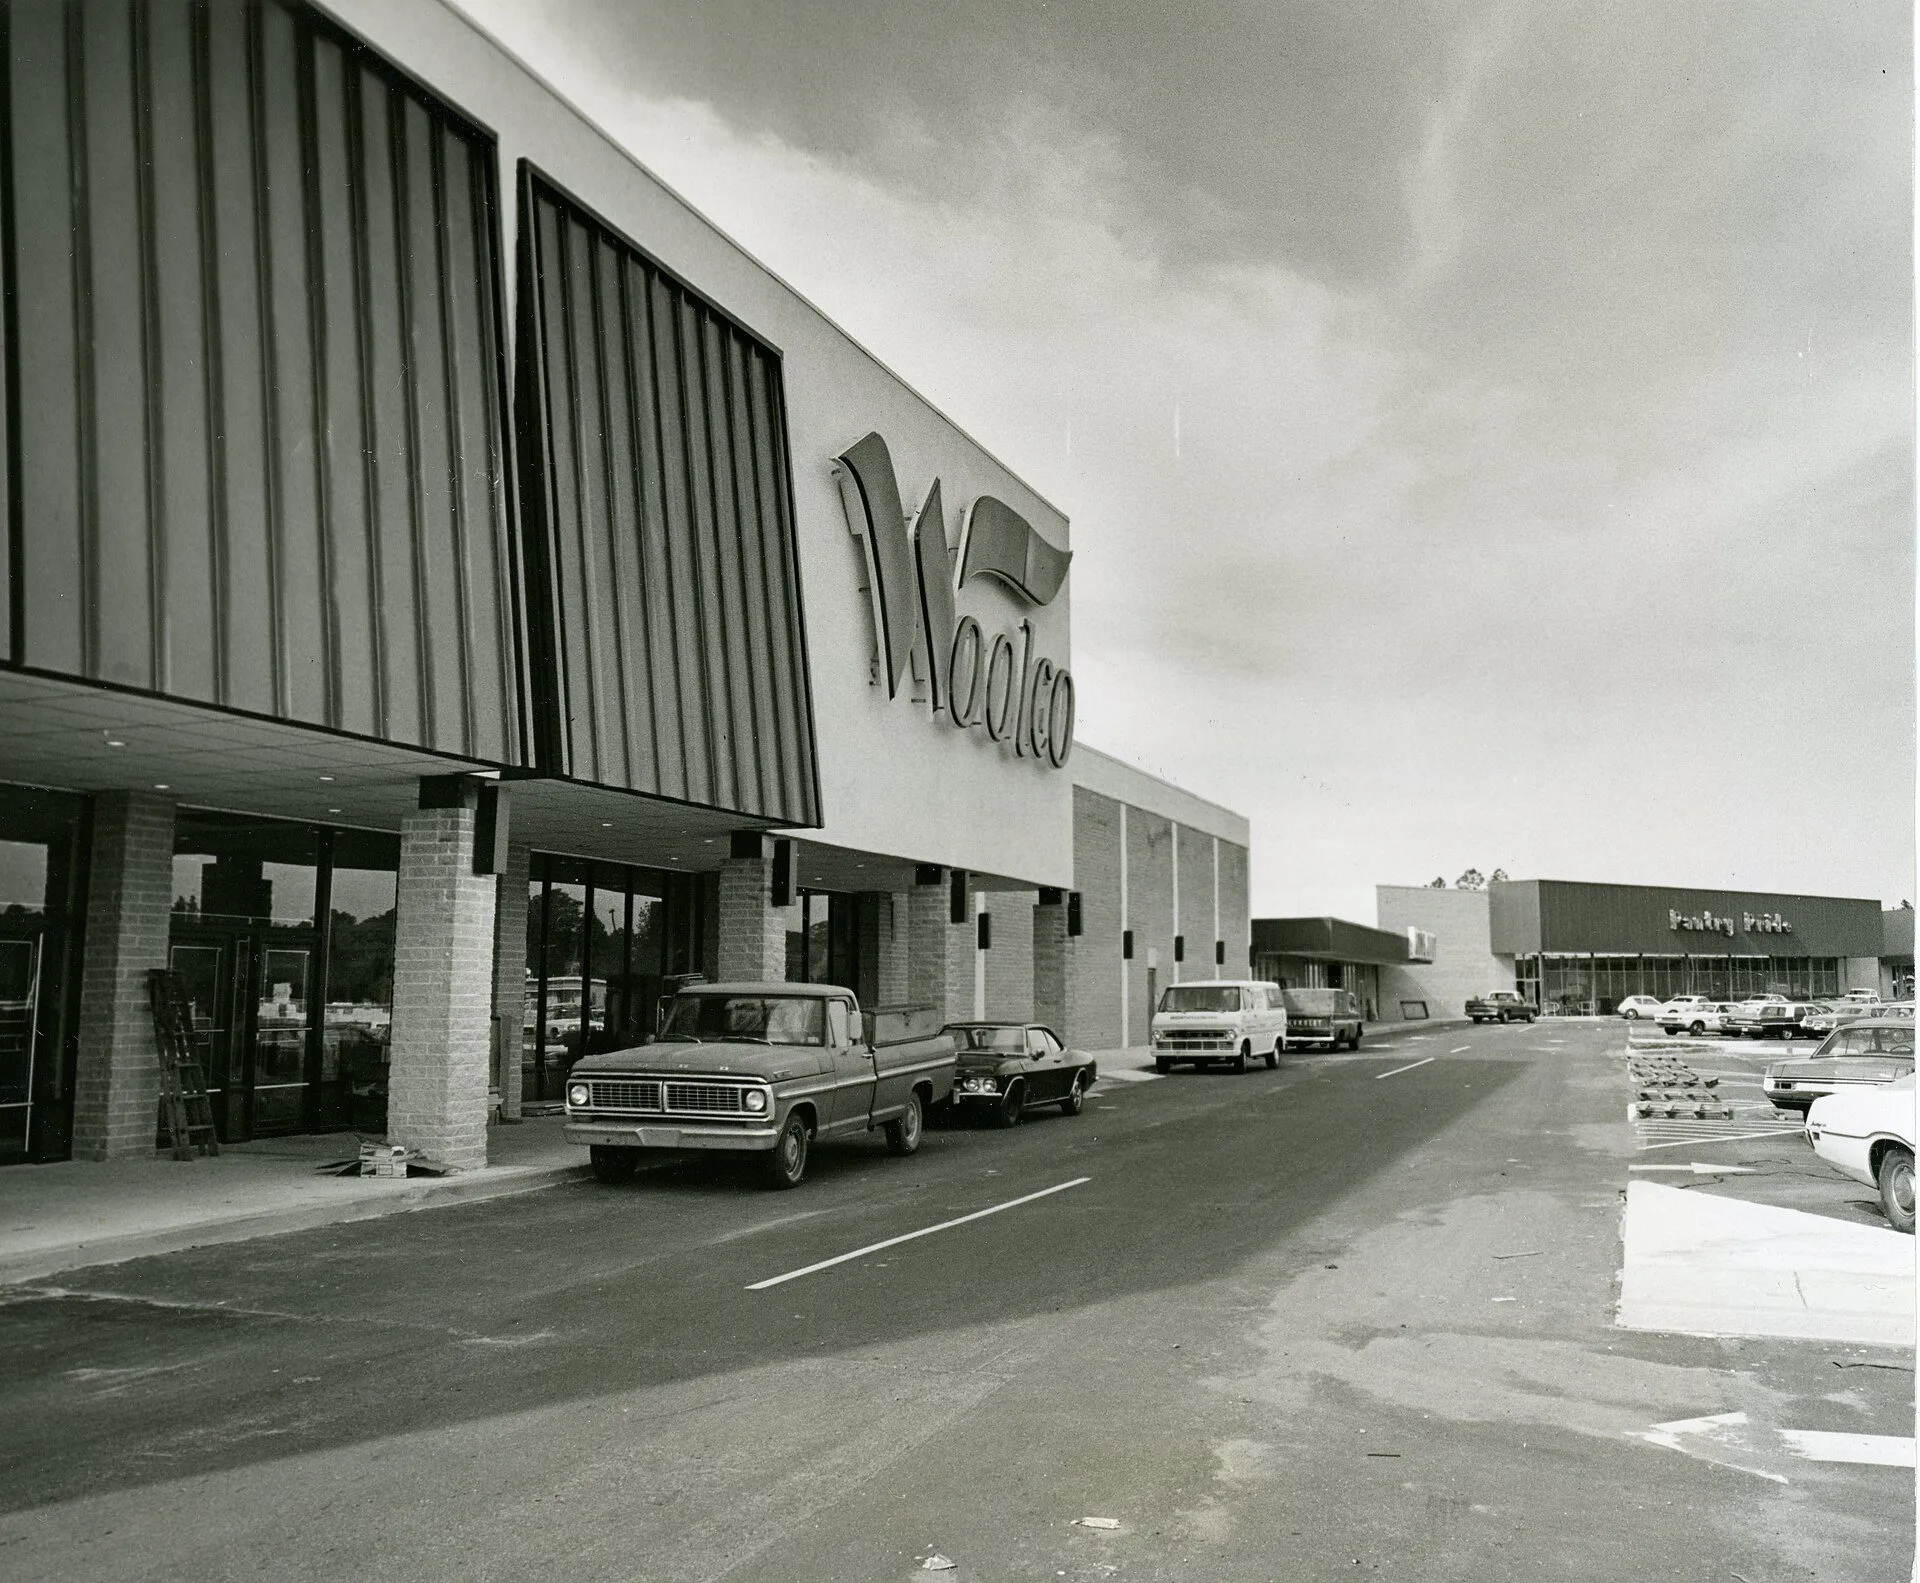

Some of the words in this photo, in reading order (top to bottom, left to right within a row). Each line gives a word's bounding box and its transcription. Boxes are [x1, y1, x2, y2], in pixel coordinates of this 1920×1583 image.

[829, 431, 1075, 769] Woolco
[1669, 909, 1734, 937] Pantry
[1743, 911, 1792, 933] Pride
